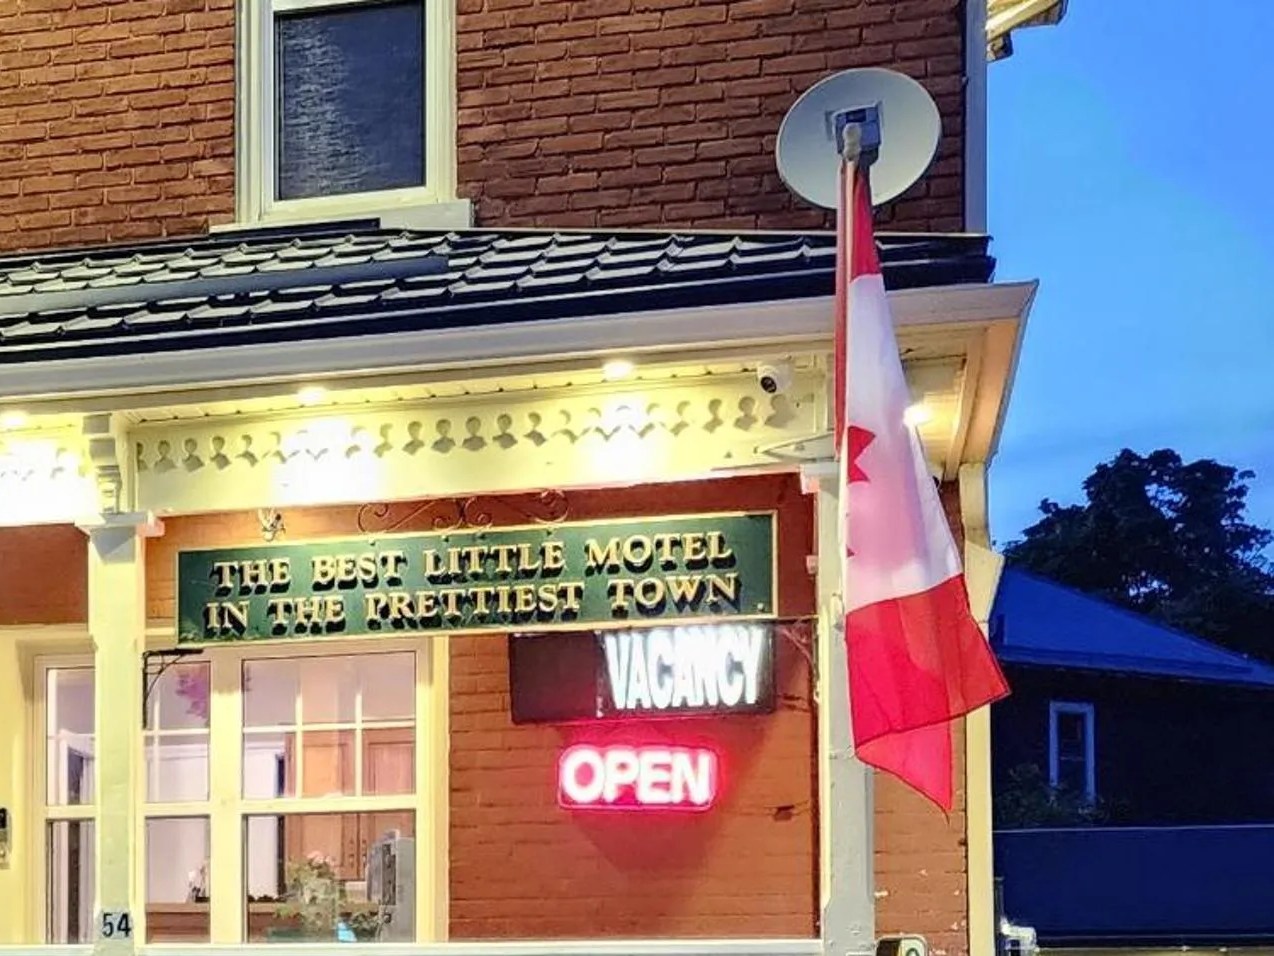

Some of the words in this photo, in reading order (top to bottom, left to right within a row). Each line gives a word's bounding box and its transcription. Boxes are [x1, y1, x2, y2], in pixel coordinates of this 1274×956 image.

[212, 558, 291, 592] THE
[311, 552, 403, 584] BEST
[424, 541, 565, 577] LITTLE
[585, 530, 733, 567] MOTEL
[205, 599, 249, 630] IN
[269, 594, 344, 626] THE
[366, 582, 585, 619] PRETTIEST
[607, 572, 738, 610] TOWN
[605, 625, 764, 709] VACANCY
[562, 749, 711, 805] OPEN
[102, 912, 131, 938] 54
